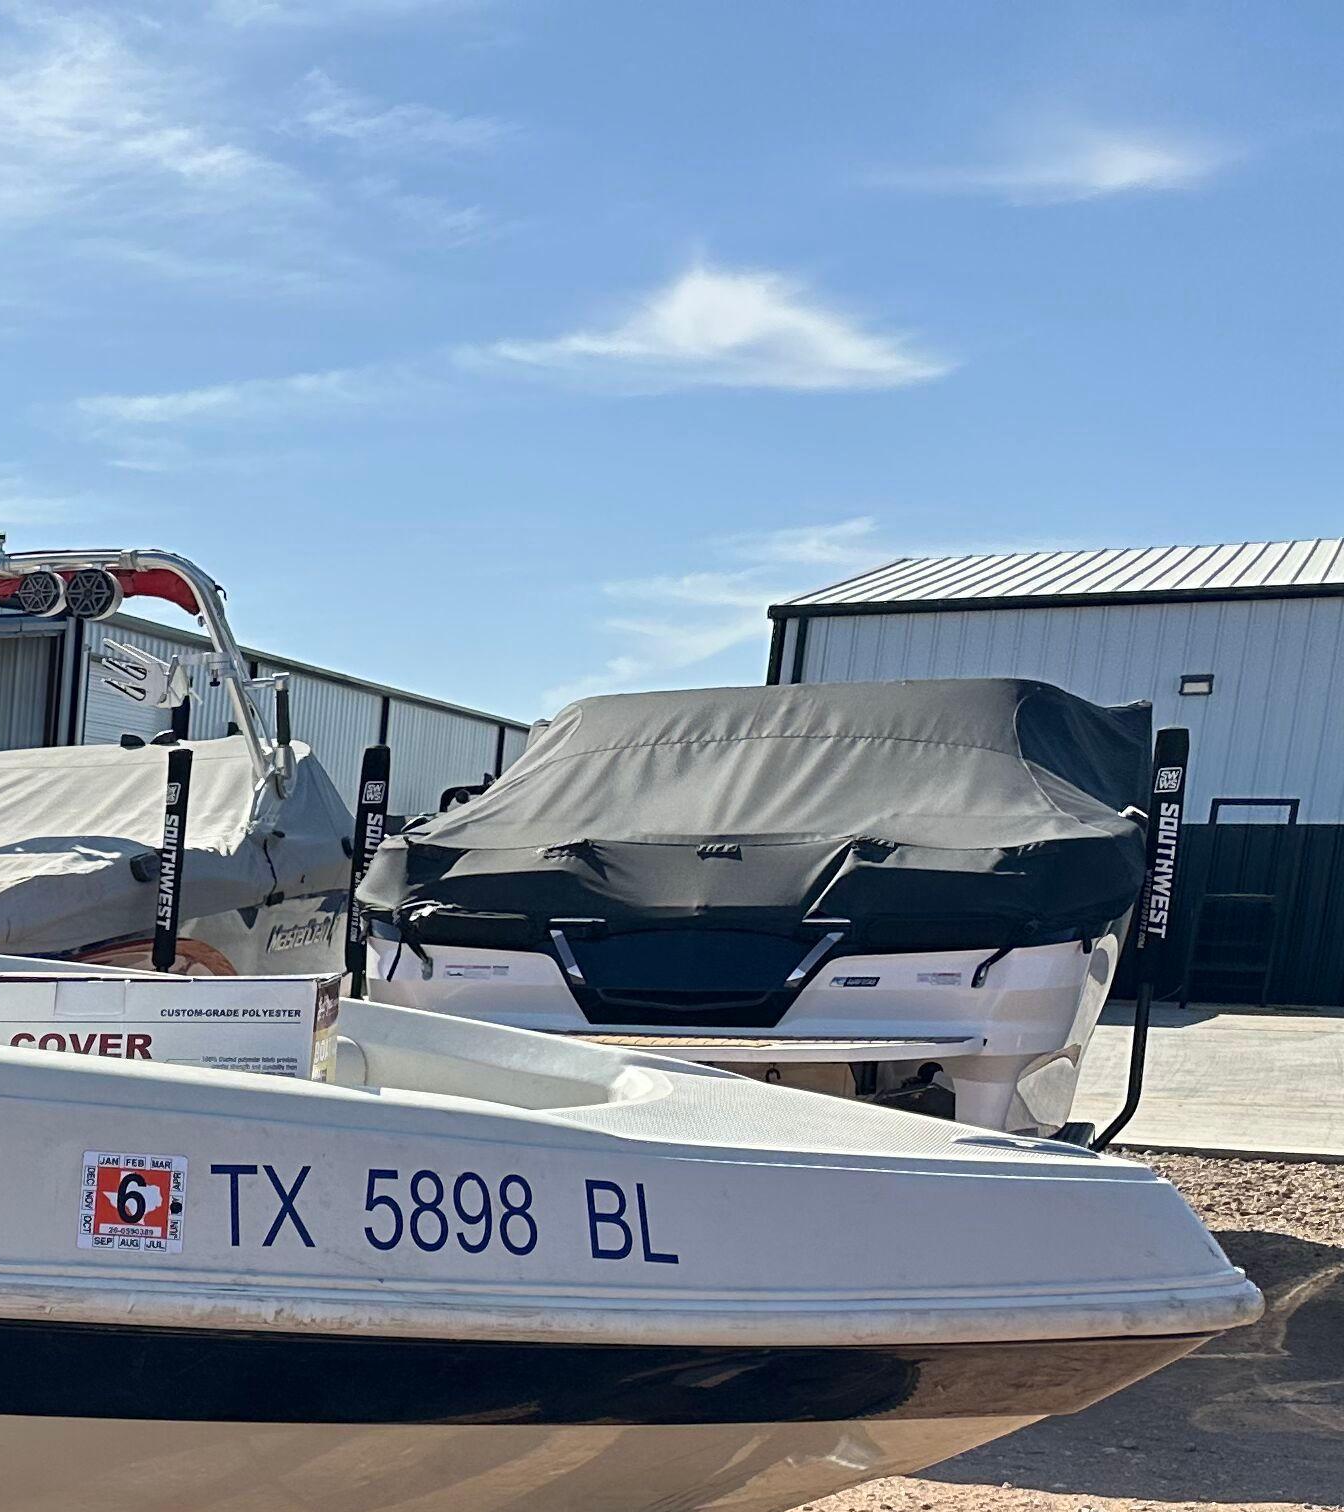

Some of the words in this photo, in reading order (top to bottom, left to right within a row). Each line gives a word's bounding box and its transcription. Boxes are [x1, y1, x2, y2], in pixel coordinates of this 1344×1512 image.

[156, 814, 180, 931] SOUTHWEST
[1147, 802, 1179, 939] SOUTHWEST
[160, 1008, 239, 1018] CUSTOM-GRADE
[241, 1009, 302, 1018] POLYESTER
[9, 1033, 153, 1060] COVER
[99, 1157, 119, 1166] JAN
[125, 1158, 145, 1167] FEB
[151, 1160, 171, 1169] MAR
[86, 1167, 96, 1186] DEC
[172, 1172, 182, 1192] APR
[84, 1191, 94, 1210] NOV
[117, 1173, 147, 1224] 6
[83, 1215, 93, 1234] OCT
[211, 1165, 316, 1248] TX
[363, 1169, 538, 1256] 5898
[584, 1178, 680, 1265] BL
[93, 1237, 113, 1246] SEP
[119, 1238, 139, 1248] AUG
[145, 1240, 165, 1249] JUL
